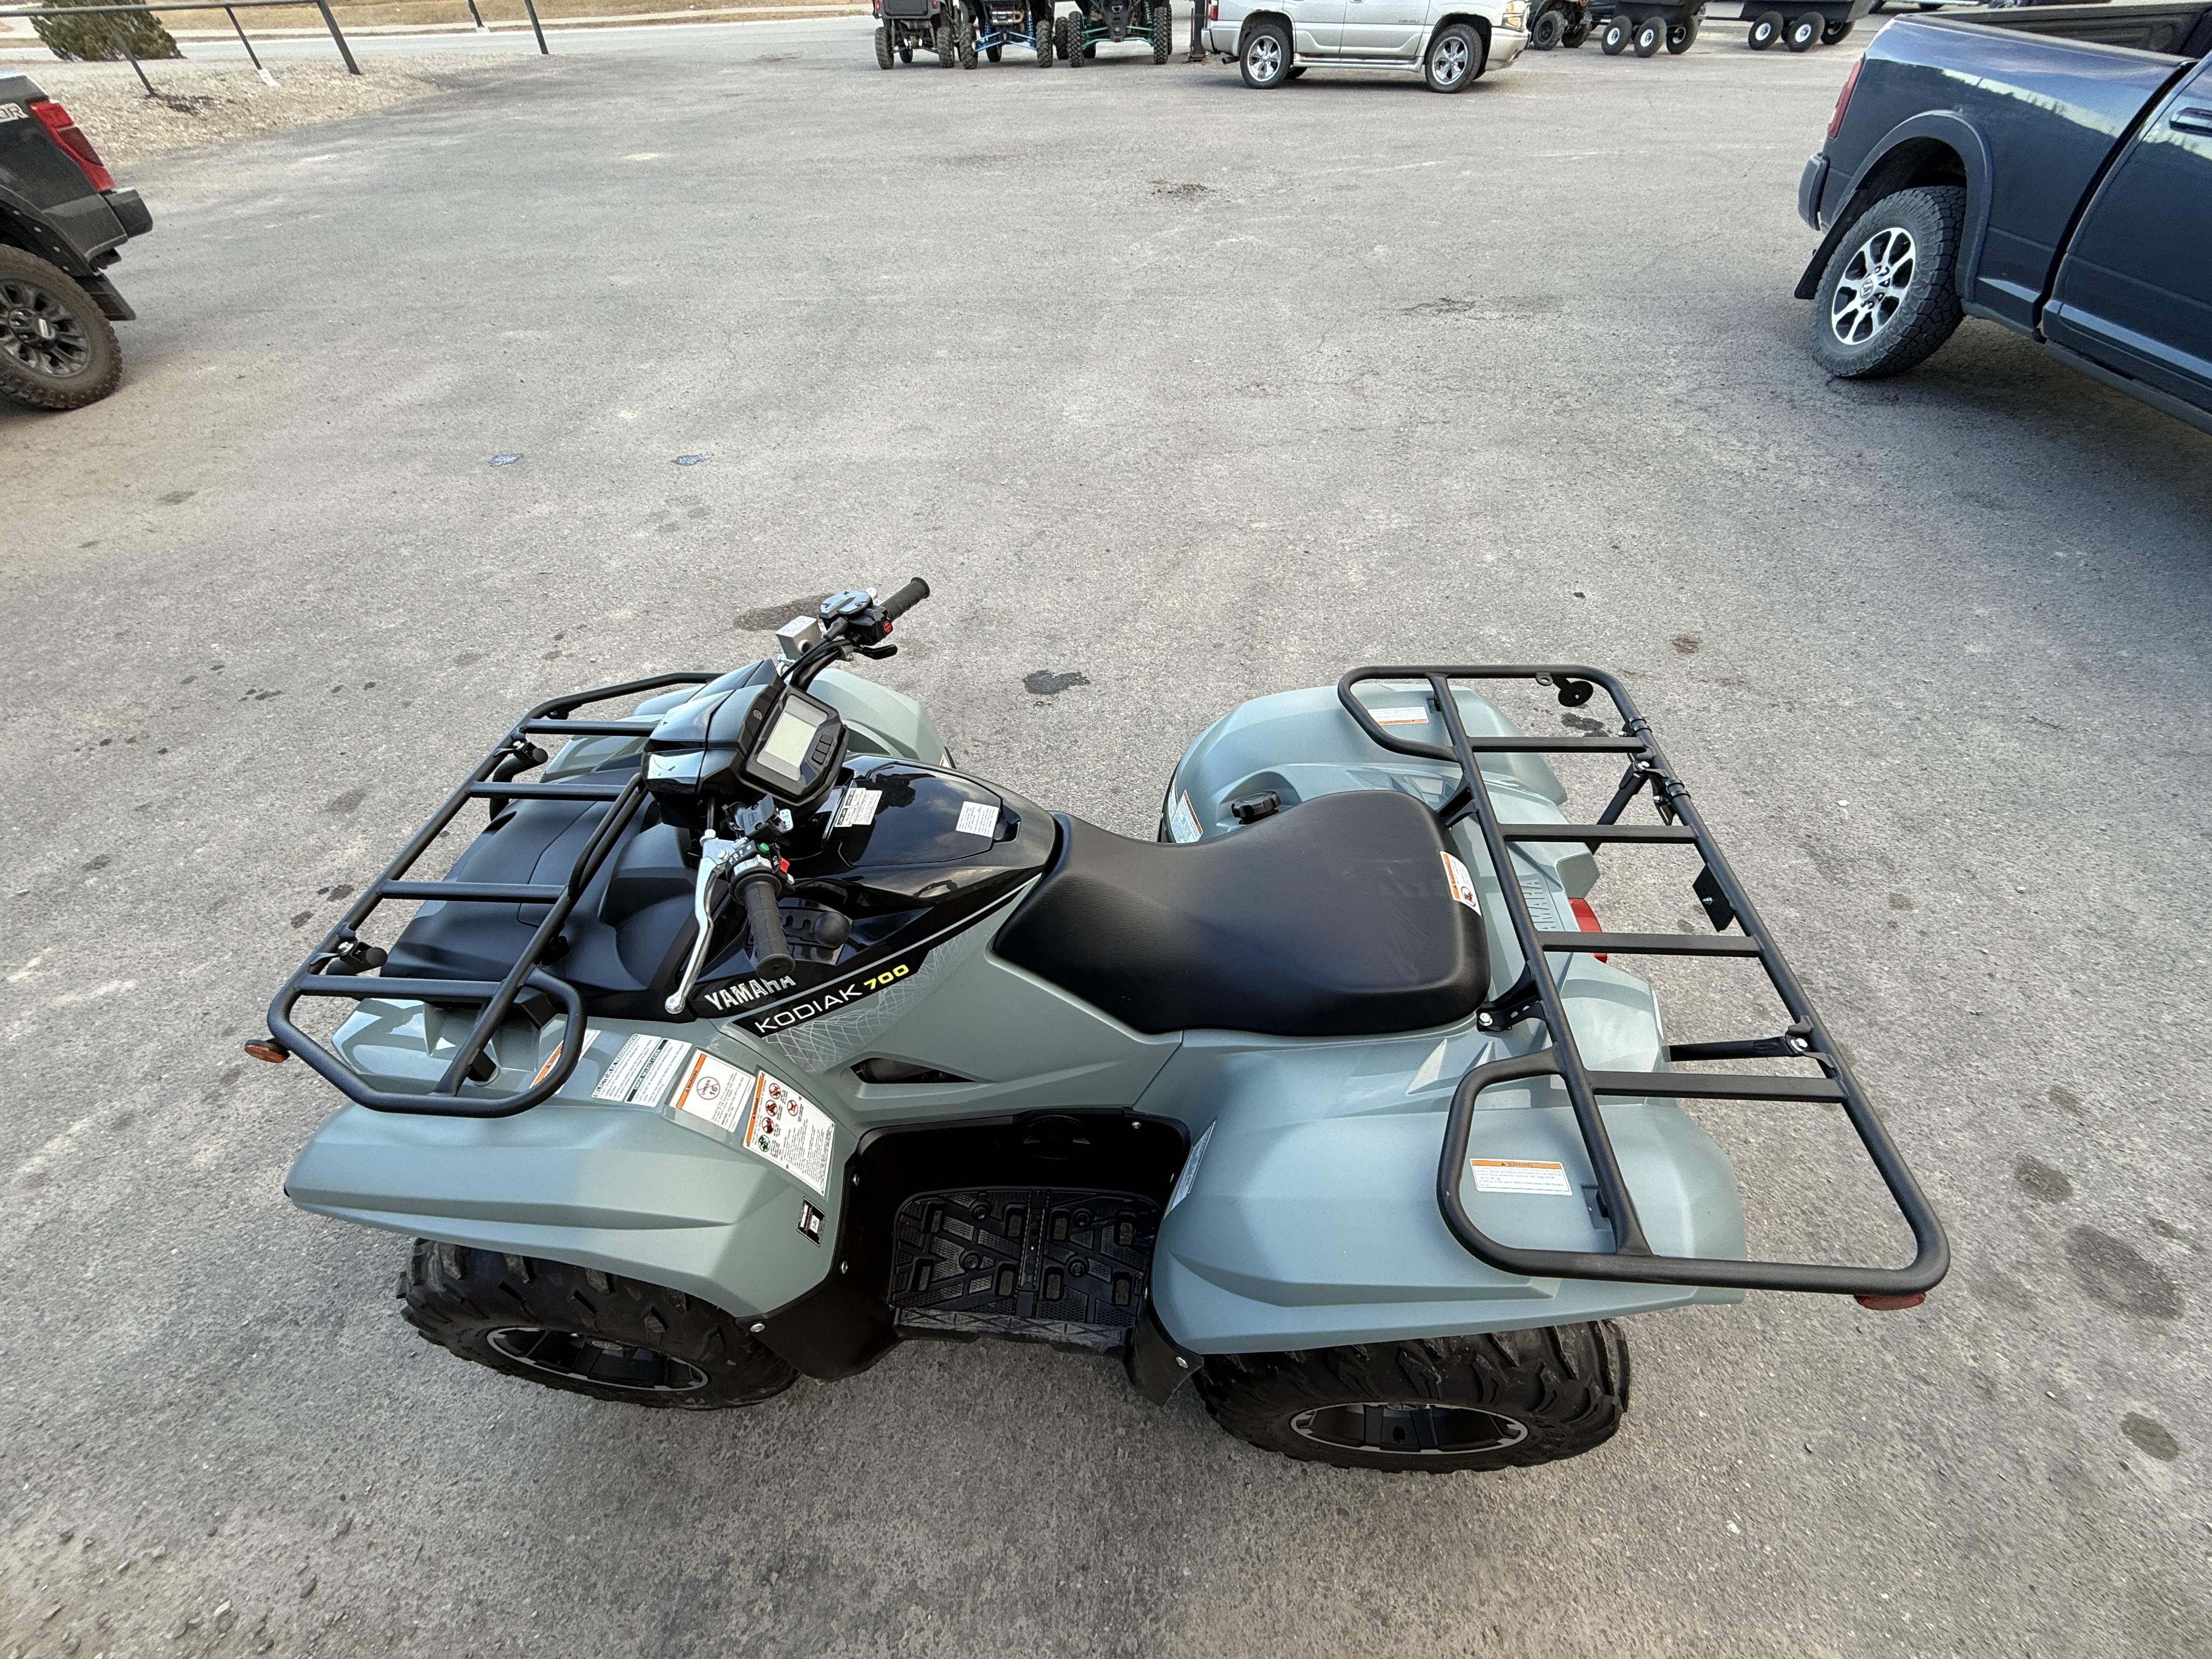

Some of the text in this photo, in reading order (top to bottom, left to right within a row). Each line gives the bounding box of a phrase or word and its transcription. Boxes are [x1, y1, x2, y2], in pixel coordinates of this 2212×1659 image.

[704, 975, 797, 1011] YAMAHA
[755, 964, 910, 1034] KODIAK 700
[640, 1061, 654, 1077] SELECT
[686, 1069, 698, 1089] WARNING
[708, 1085, 718, 1097] 16
